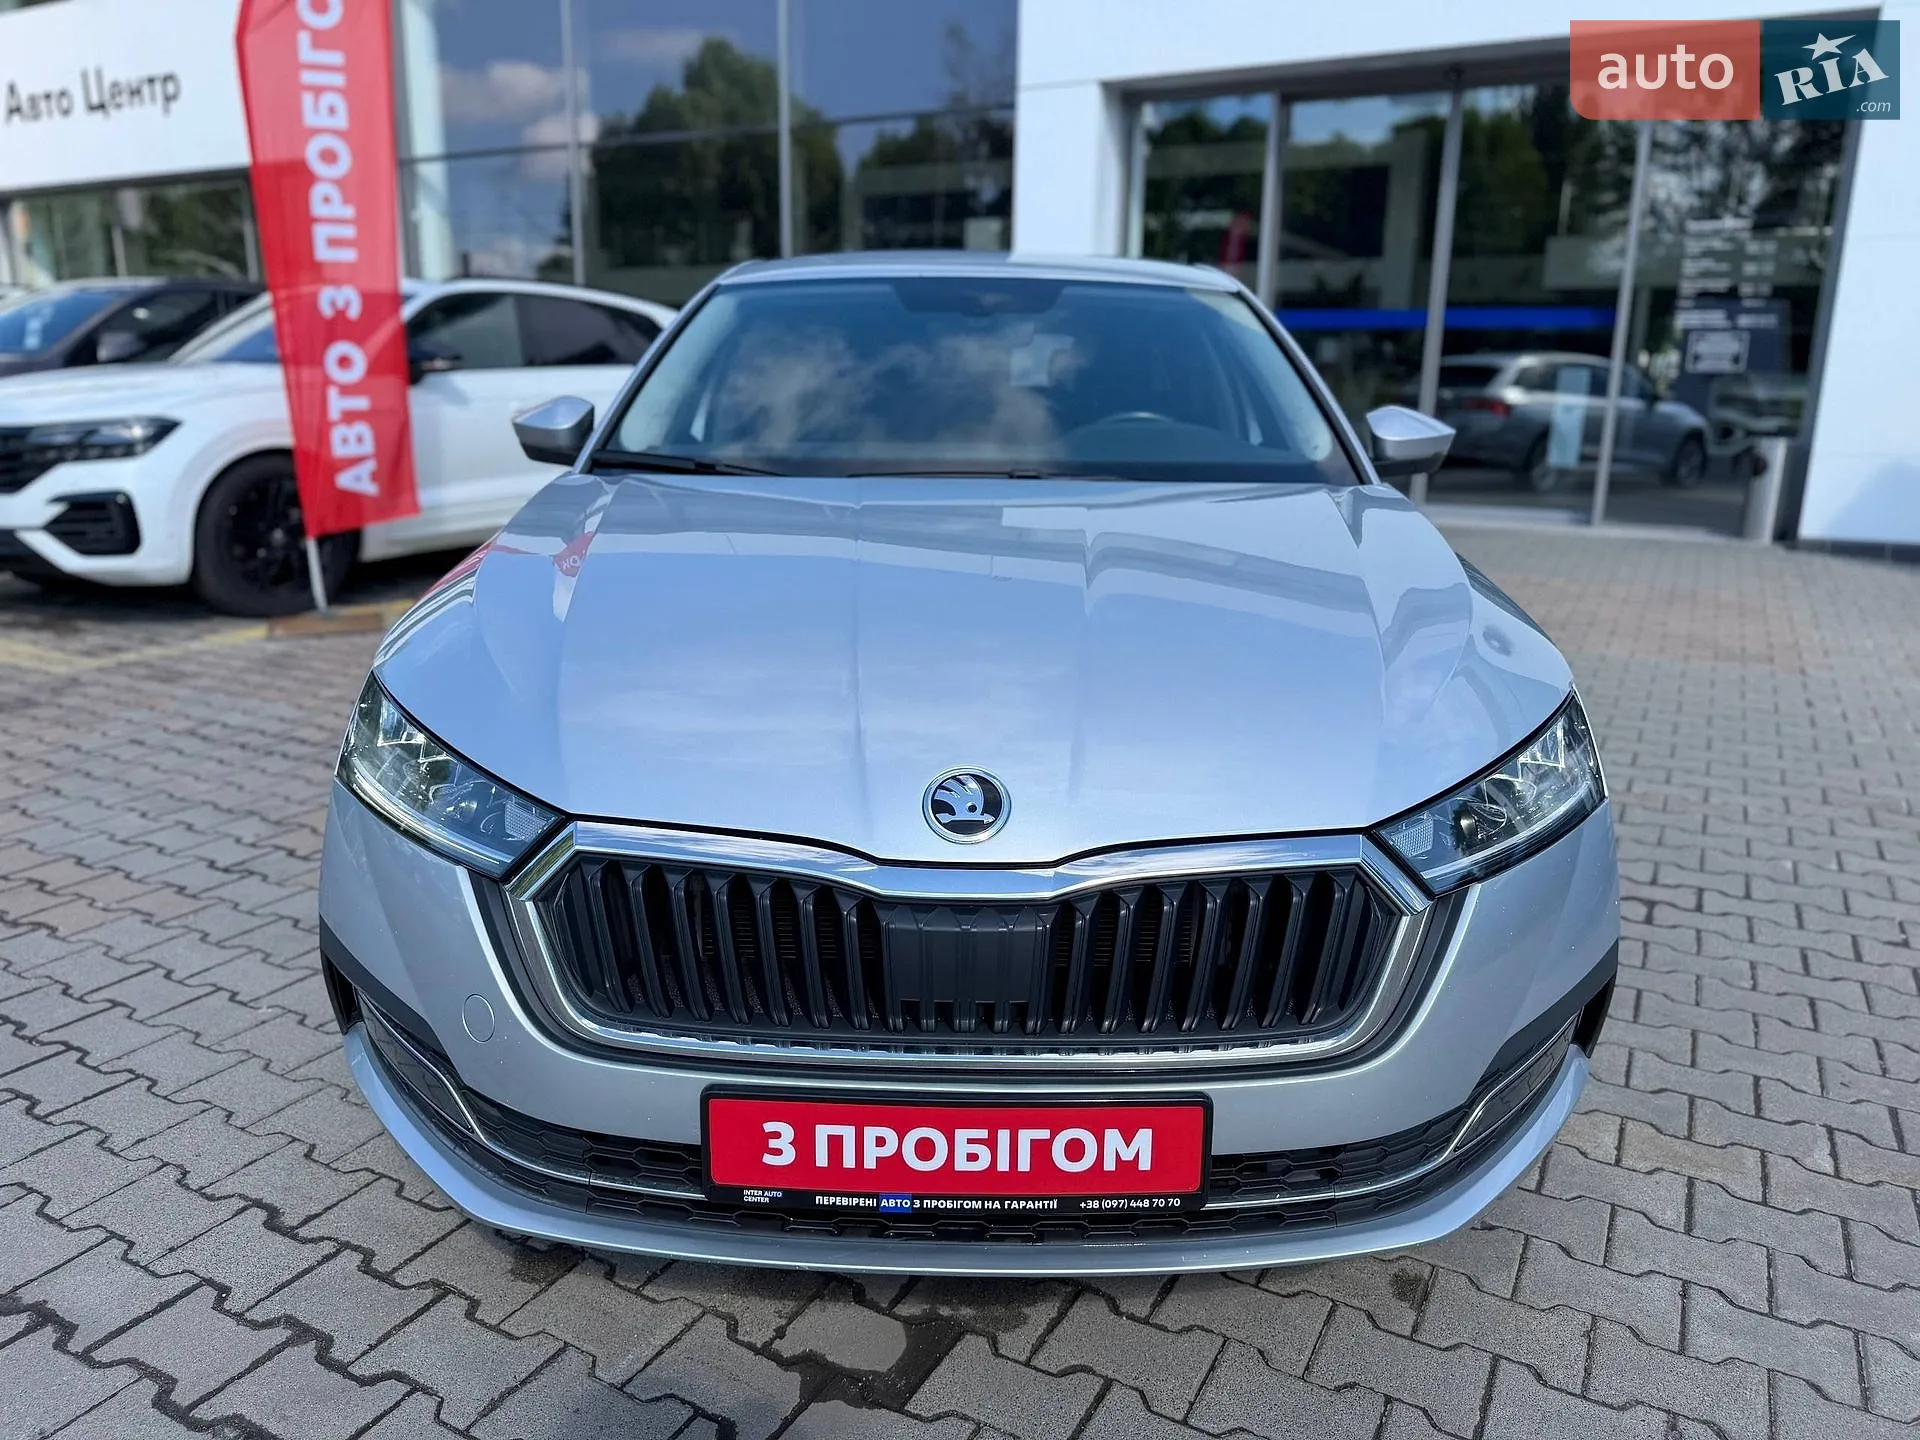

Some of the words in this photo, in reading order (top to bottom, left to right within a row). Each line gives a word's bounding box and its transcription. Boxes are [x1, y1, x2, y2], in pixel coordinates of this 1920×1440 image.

[5, 79, 74, 126] Авто
[80, 65, 181, 119] Центр
[317, 284, 363, 320] З
[324, 340, 379, 497] АВТО
[762, 1121, 796, 1167] З
[815, 1124, 1152, 1172] ПРОБІГОМ
[743, 1189, 763, 1197] INTER
[815, 1195, 877, 1207] ПЕРЕВІРЕНІ
[880, 1198, 911, 1208] АВТО
[913, 1199, 921, 1208] З
[923, 1199, 982, 1210] ПРОБІГОМ
[984, 1200, 1001, 1209] НА
[1004, 1198, 1058, 1210] ГАРАНТІЇ
[1080, 1199, 1100, 1209] +38
[1101, 1198, 1128, 1210] (097)
[1129, 1198, 1150, 1208] 448
[1152, 1198, 1165, 1208] 70
[1167, 1197, 1181, 1207] 70
